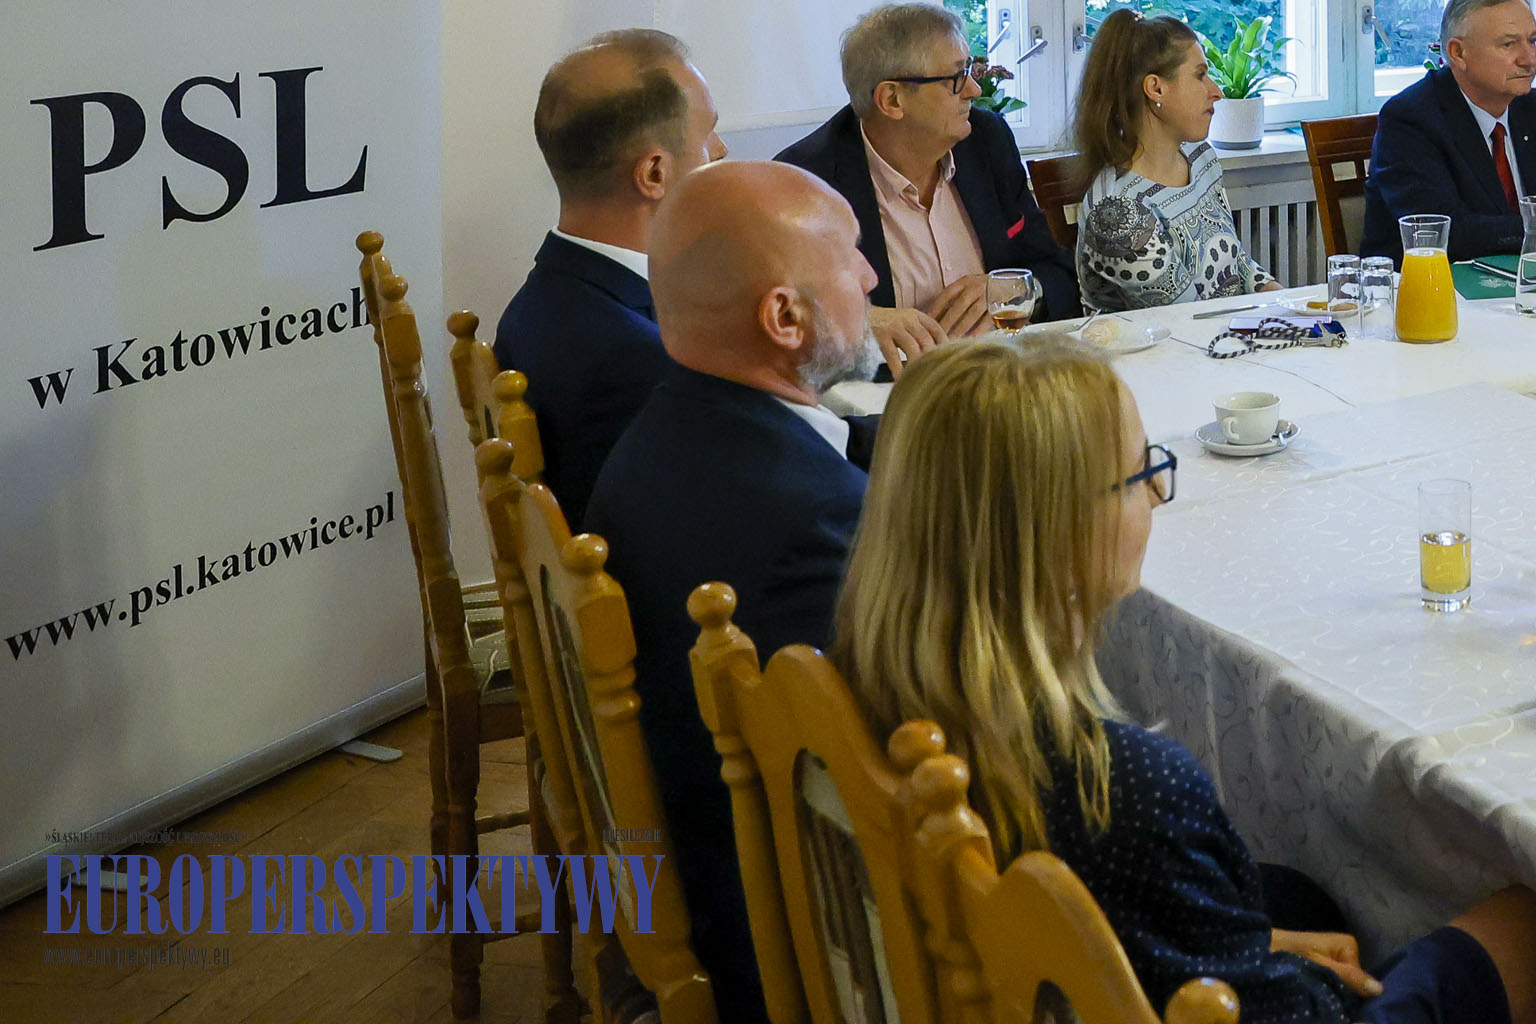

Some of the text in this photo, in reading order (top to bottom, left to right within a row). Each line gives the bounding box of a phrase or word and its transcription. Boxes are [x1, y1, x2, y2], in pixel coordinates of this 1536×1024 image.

[30, 66, 368, 252] PSL
[27, 286, 370, 410] w Katowicach
[4, 491, 395, 661] www.psl.katowice.pl
